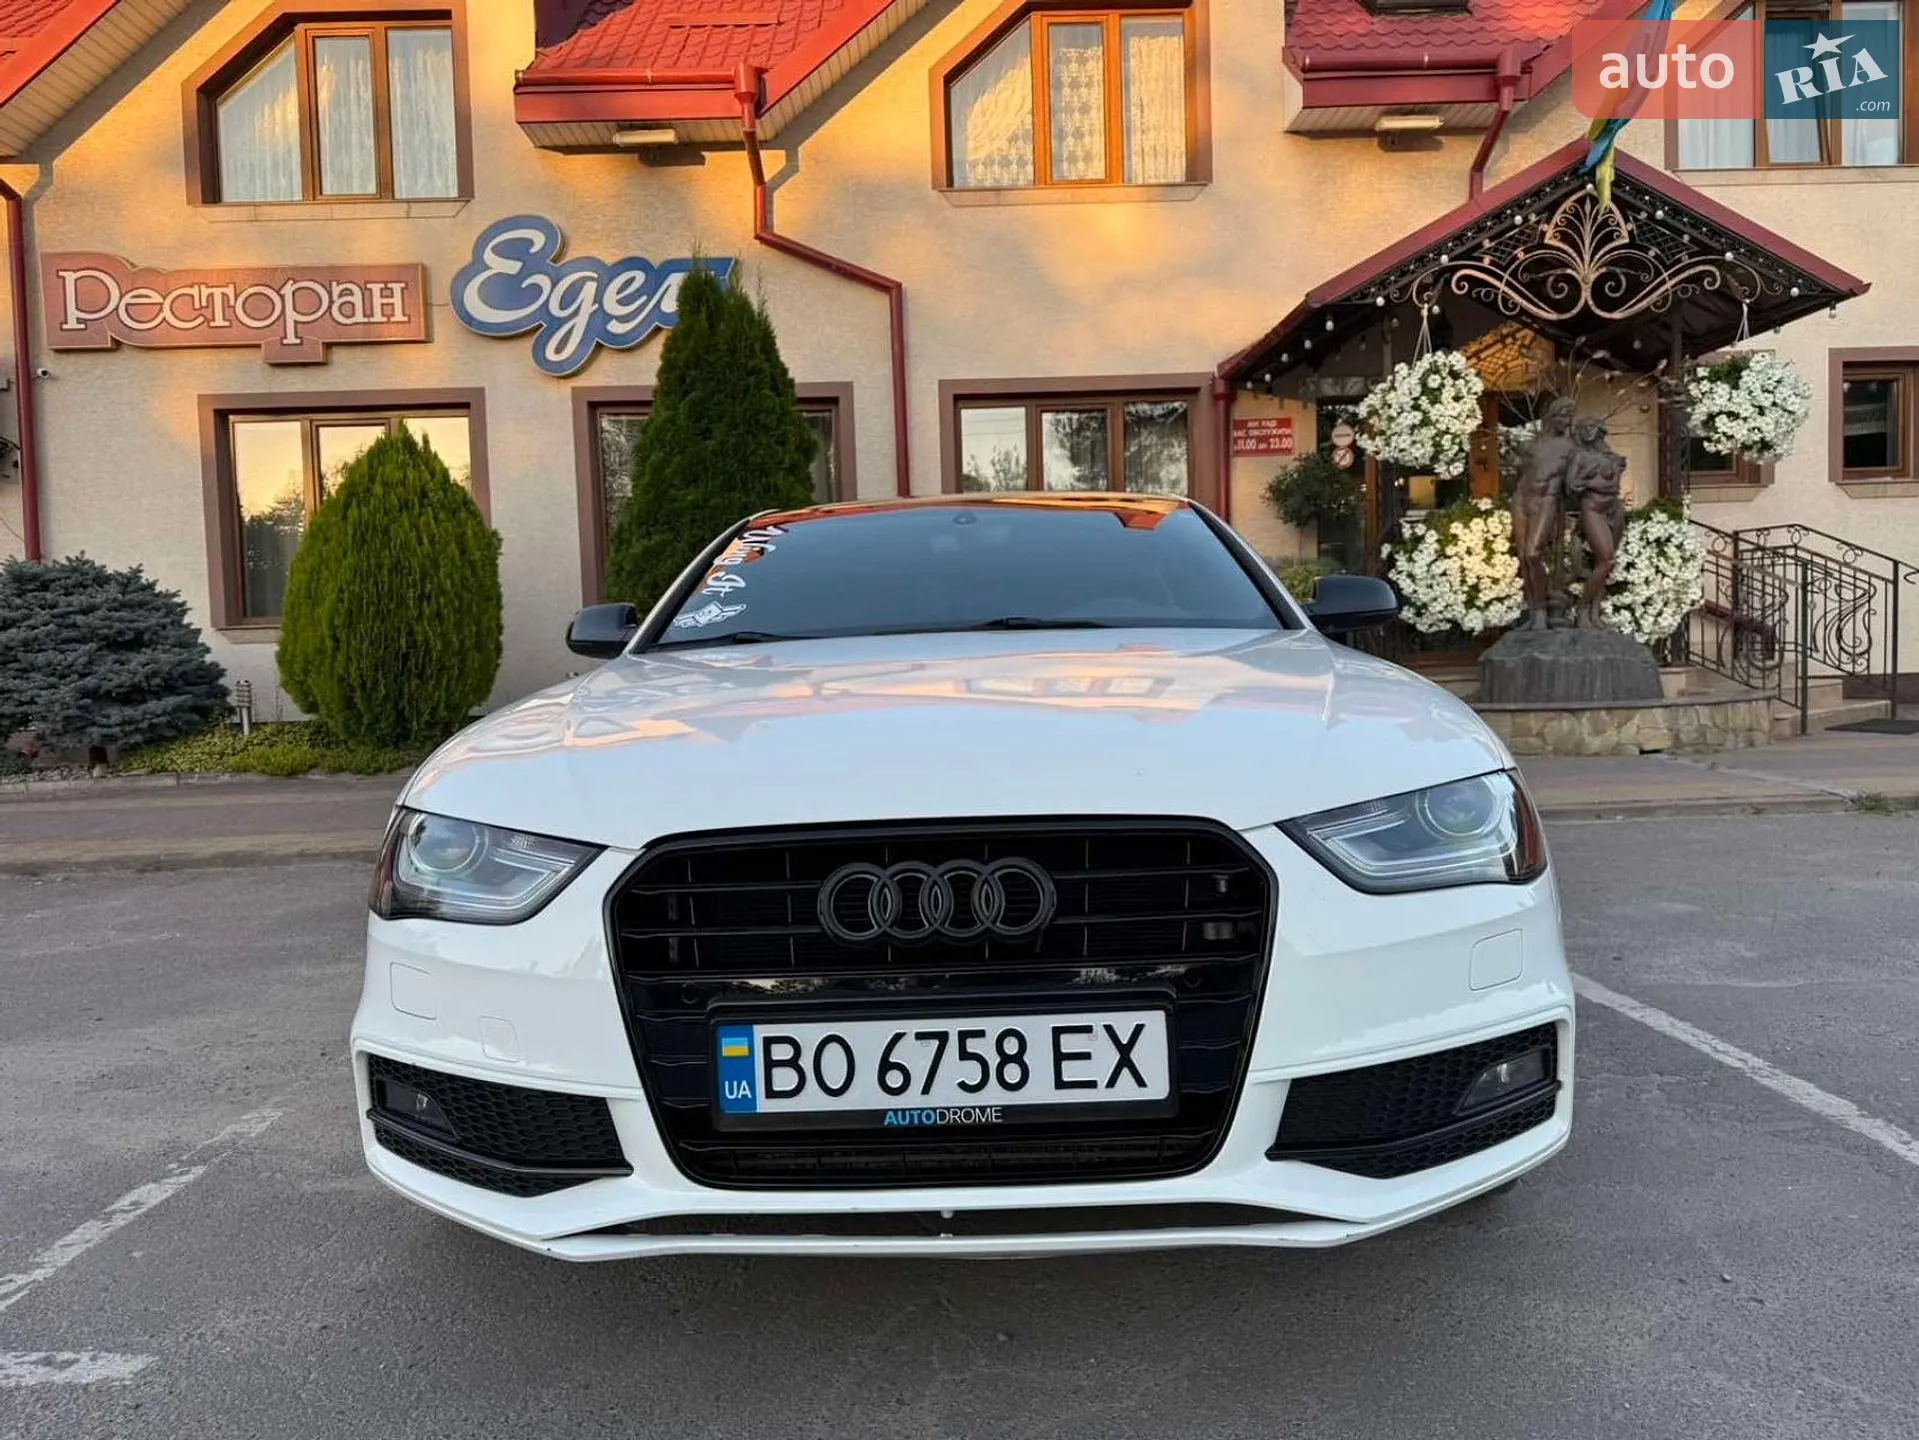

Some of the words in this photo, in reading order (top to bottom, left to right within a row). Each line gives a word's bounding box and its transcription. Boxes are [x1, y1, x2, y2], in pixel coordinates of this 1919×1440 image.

[57, 268, 410, 346] Ресторан
[761, 1033, 856, 1099] BO
[877, 1028, 1030, 1096] 6758
[1051, 1022, 1148, 1091] EX
[724, 1081, 752, 1100] UA
[883, 1107, 1003, 1127] AUTODROME
